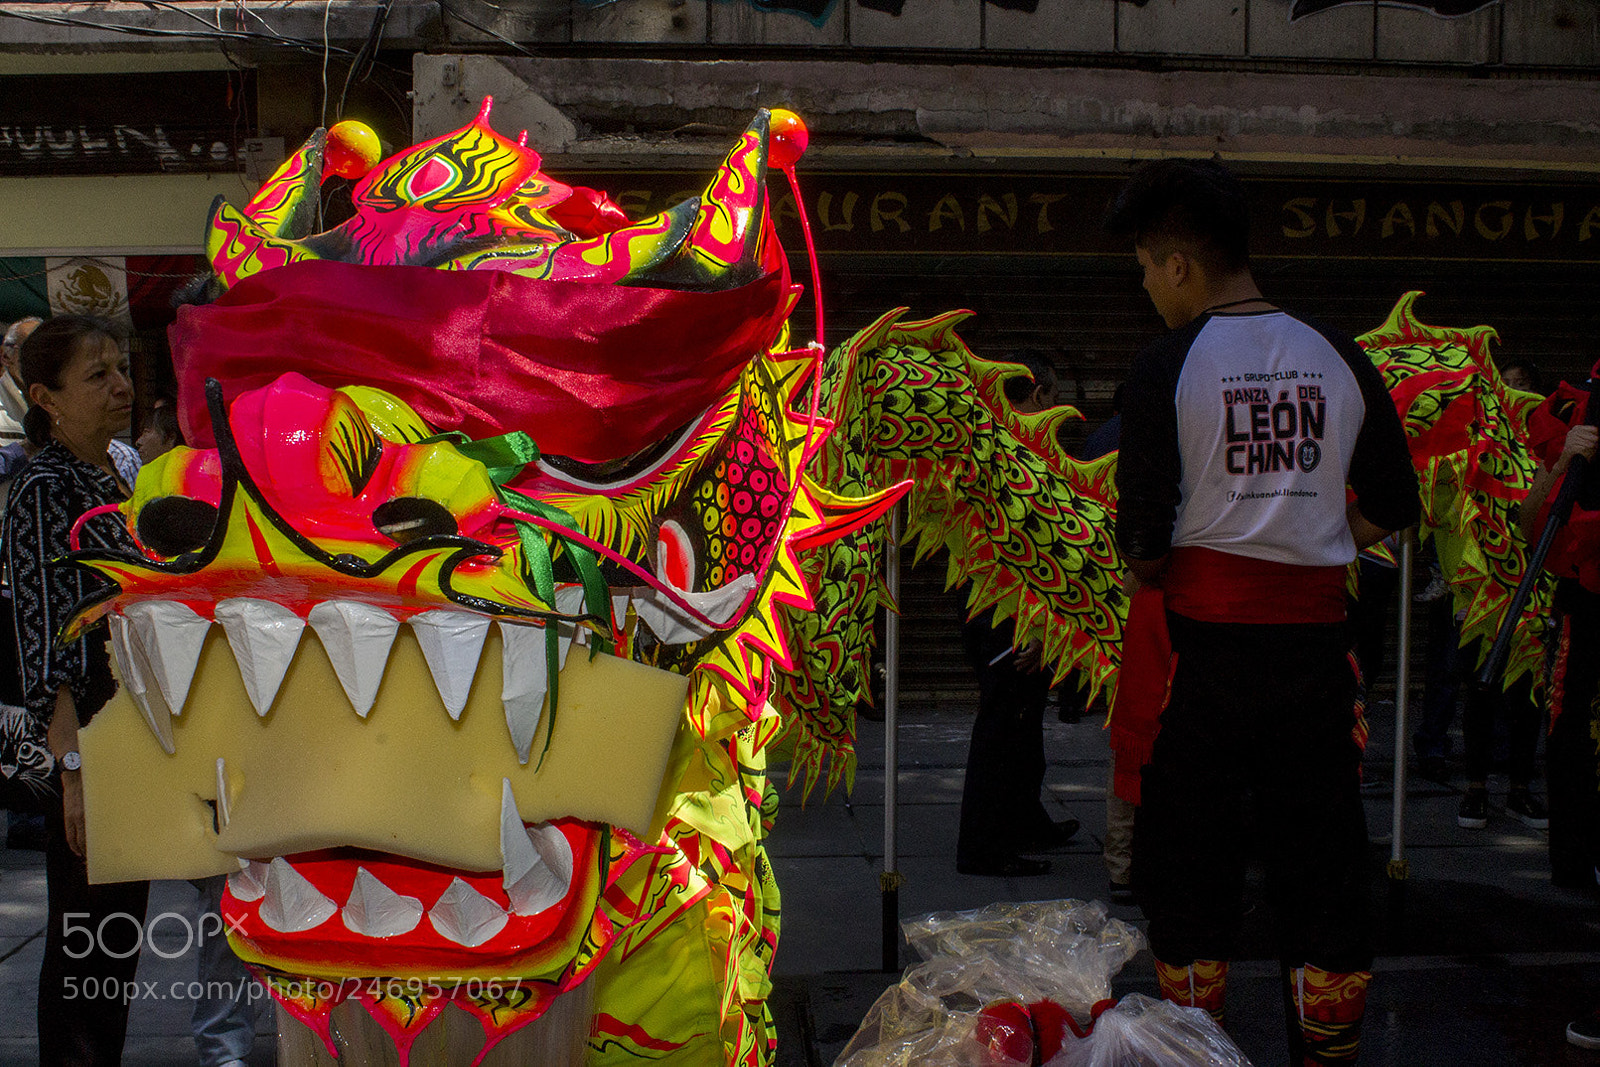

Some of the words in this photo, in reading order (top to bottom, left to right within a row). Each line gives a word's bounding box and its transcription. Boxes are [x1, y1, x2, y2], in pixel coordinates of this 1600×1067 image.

[1243, 370, 1299, 382] GRUPO-CLUB
[1224, 387, 1270, 405] DANZA
[1297, 384, 1326, 401] DEL
[1225, 390, 1326, 445] LEÓN
[1225, 438, 1321, 476] CHINO
